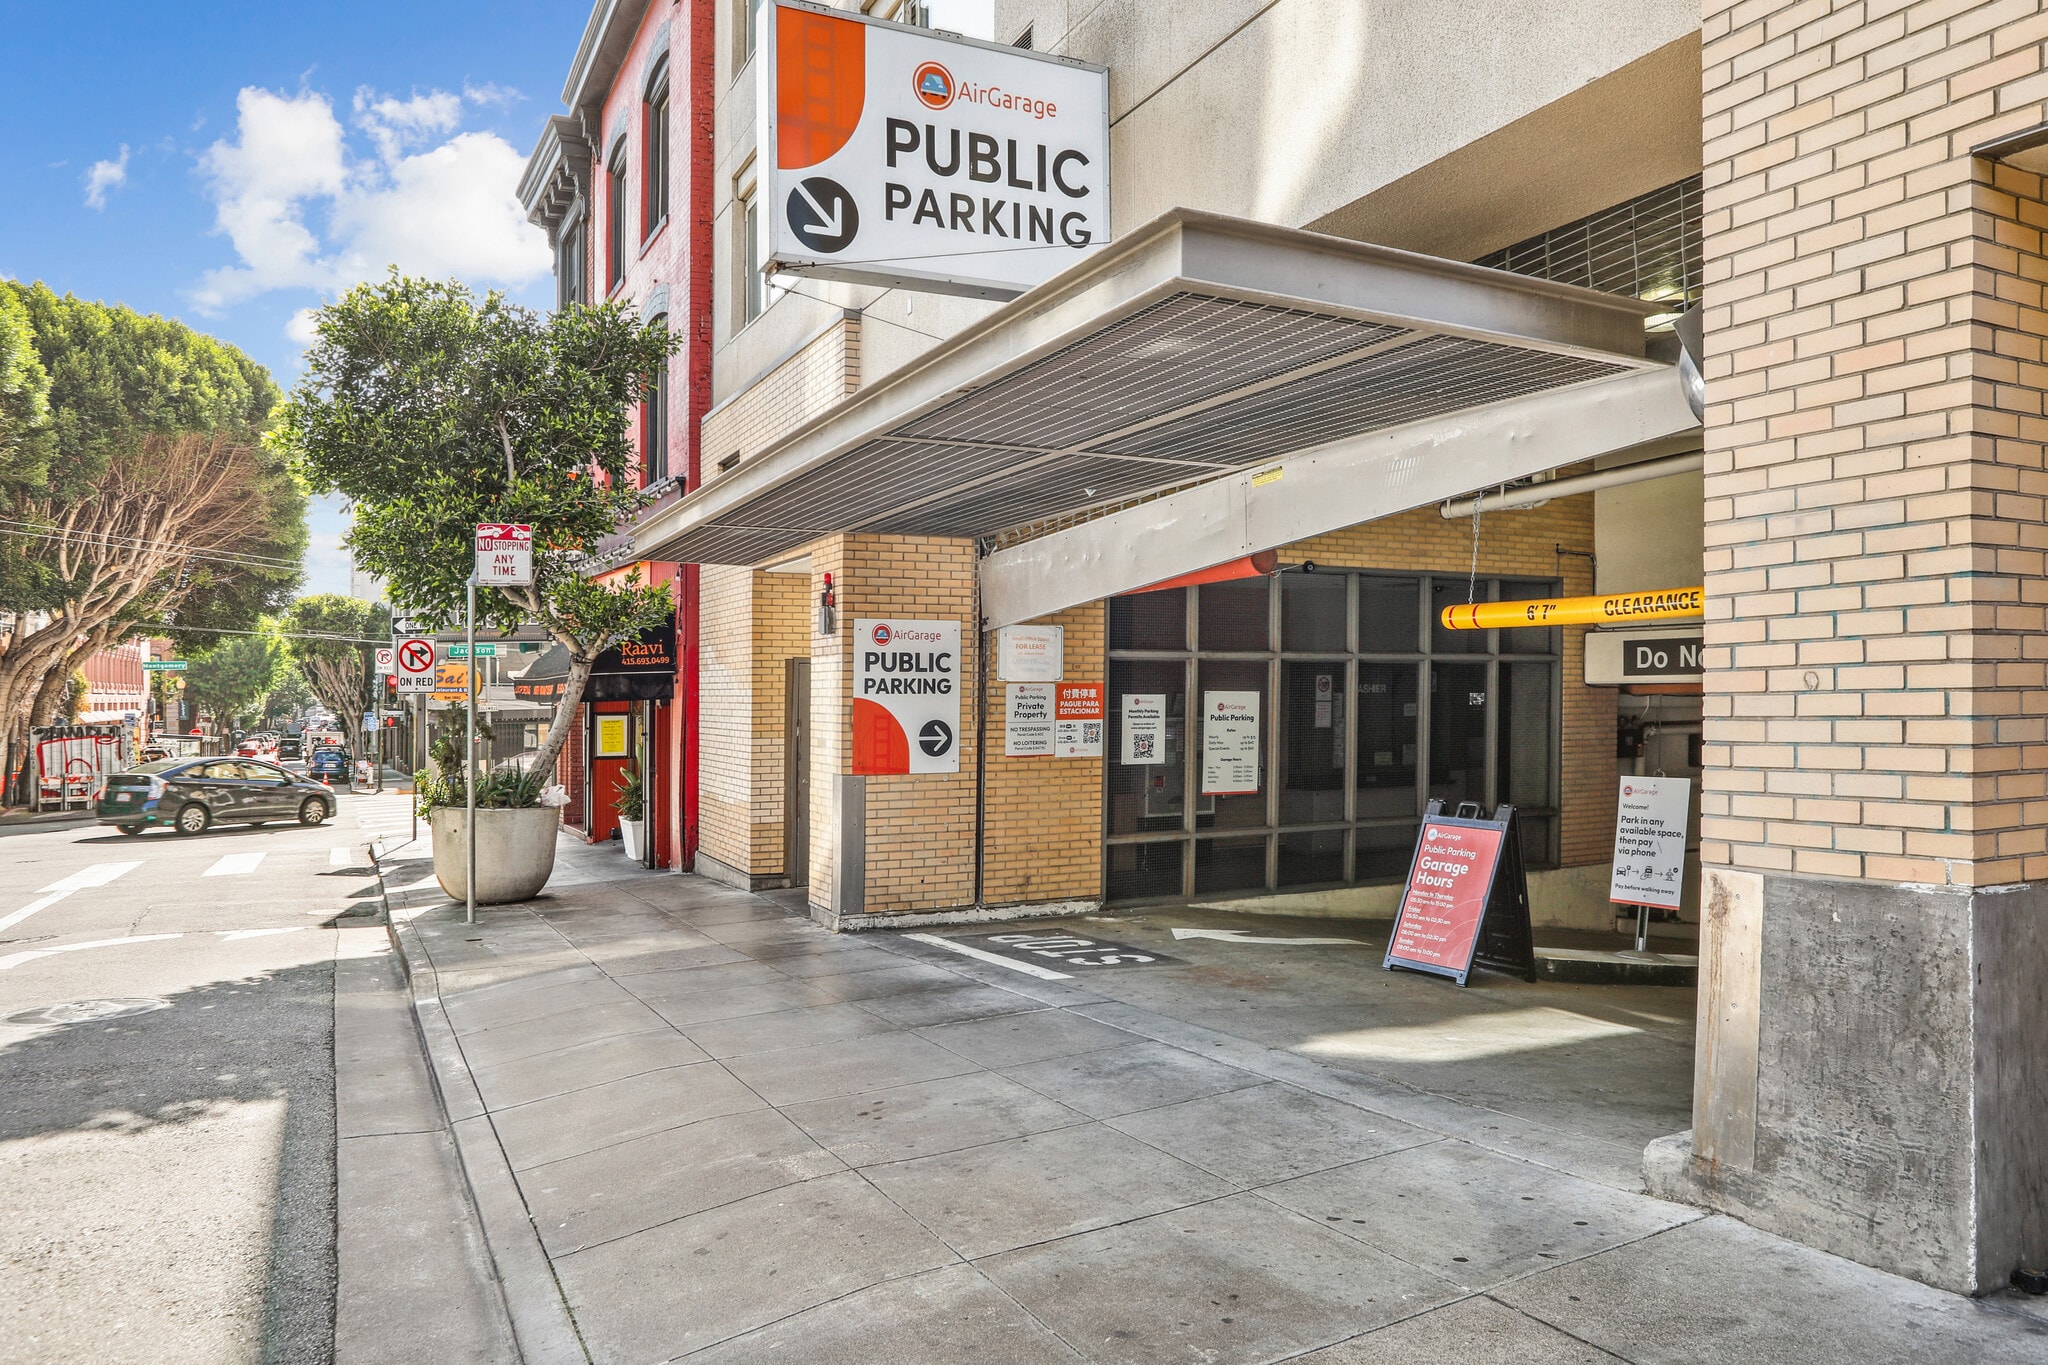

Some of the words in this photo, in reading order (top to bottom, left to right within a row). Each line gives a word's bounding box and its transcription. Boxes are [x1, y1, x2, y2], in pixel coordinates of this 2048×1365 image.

[957, 81, 1057, 120] AirGarage
[886, 117, 1090, 198] PUBLIC
[885, 182, 1092, 249] PARKING
[479, 538, 492, 550] NO
[494, 541, 529, 551] STOPPING
[494, 554, 514, 564] ANY
[492, 566, 516, 576] TIME
[1604, 592, 1700, 616] CLEARANCE
[893, 630, 942, 642] AirGarage
[622, 639, 664, 656] Raavi
[622, 657, 670, 666] 415.693.0499
[865, 652, 951, 672] PUBLIC
[1636, 647, 1668, 669] Do
[400, 678, 412, 686] ON
[416, 678, 433, 686] RED
[864, 678, 952, 694] PARKING
[1063, 689, 1097, 698] 付費停車
[1014, 711, 1047, 719] Property
[1230, 714, 1254, 722] Parking
[1634, 789, 1658, 798] AirGarage
[1621, 816, 1639, 824] Park
[1650, 819, 1664, 827] any
[1437, 832, 1461, 841] AirGarage
[1620, 827, 1656, 836] available
[1657, 830, 1684, 839] space,
[1620, 837, 1637, 845] then
[1638, 839, 1653, 848] pay
[1424, 844, 1446, 854] Public
[1447, 847, 1476, 860] Parking
[1631, 849, 1656, 858] phone
[1421, 856, 1469, 877] Garage
[1416, 871, 1454, 888] Hours
[1641, 886, 1660, 894] walking
[1403, 921, 1422, 930] Saturday
[1399, 937, 1414, 945] Sunday
